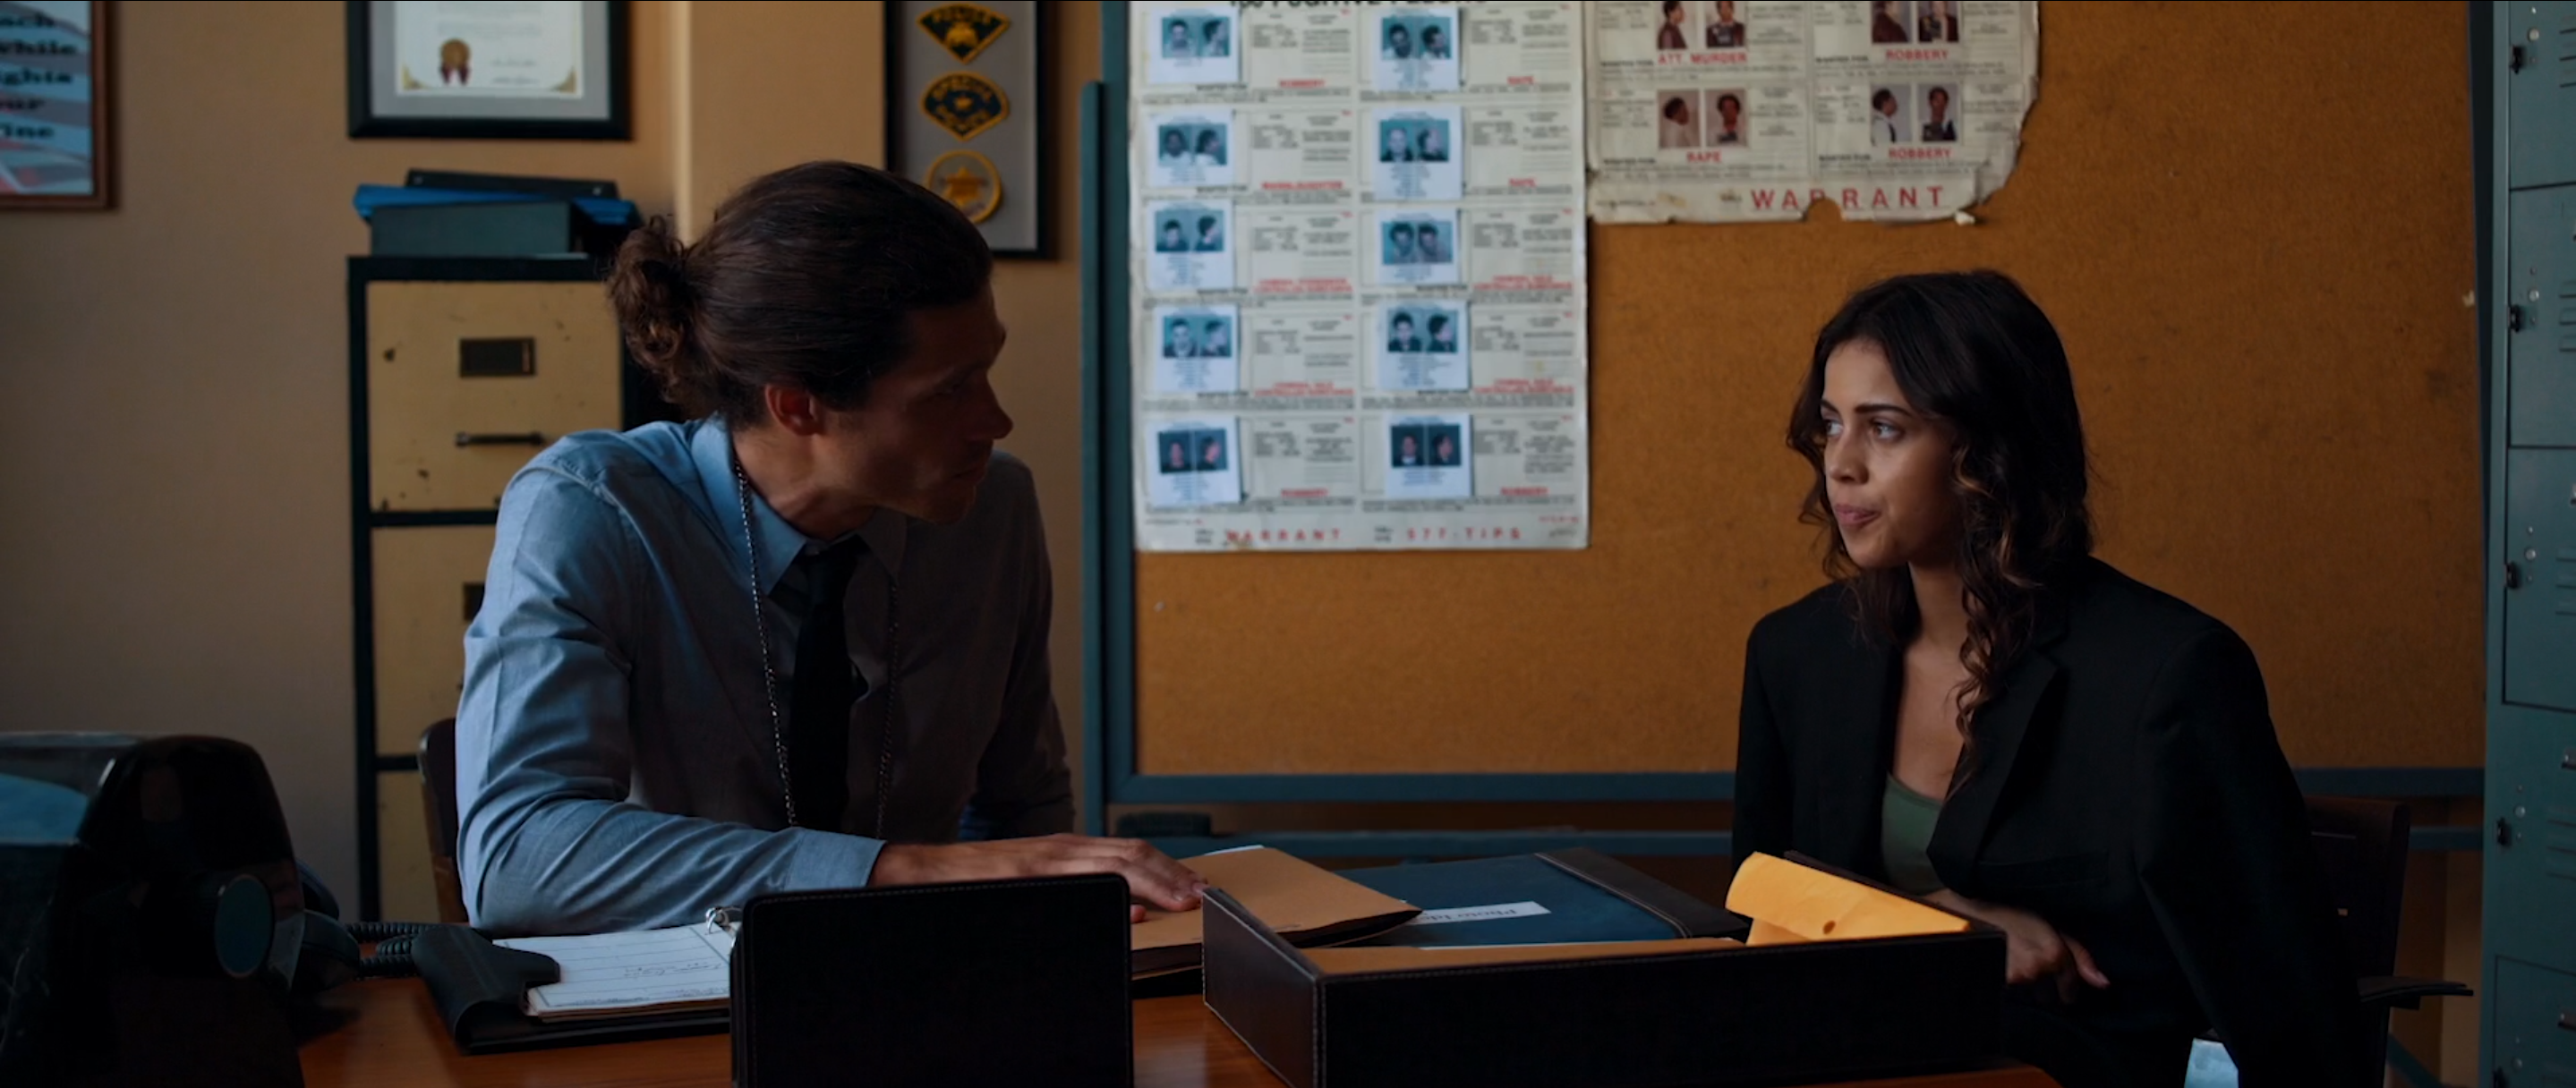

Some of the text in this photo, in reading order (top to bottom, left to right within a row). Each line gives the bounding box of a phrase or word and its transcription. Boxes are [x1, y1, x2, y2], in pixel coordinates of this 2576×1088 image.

[1690, 51, 1748, 64] MURDER
[1885, 48, 1949, 62] ROBBERY
[0, 68, 73, 86] ghts
[1687, 149, 1723, 163] RAPE
[1888, 148, 1953, 160] ROBBERY
[1752, 187, 1945, 211] WARRANT
